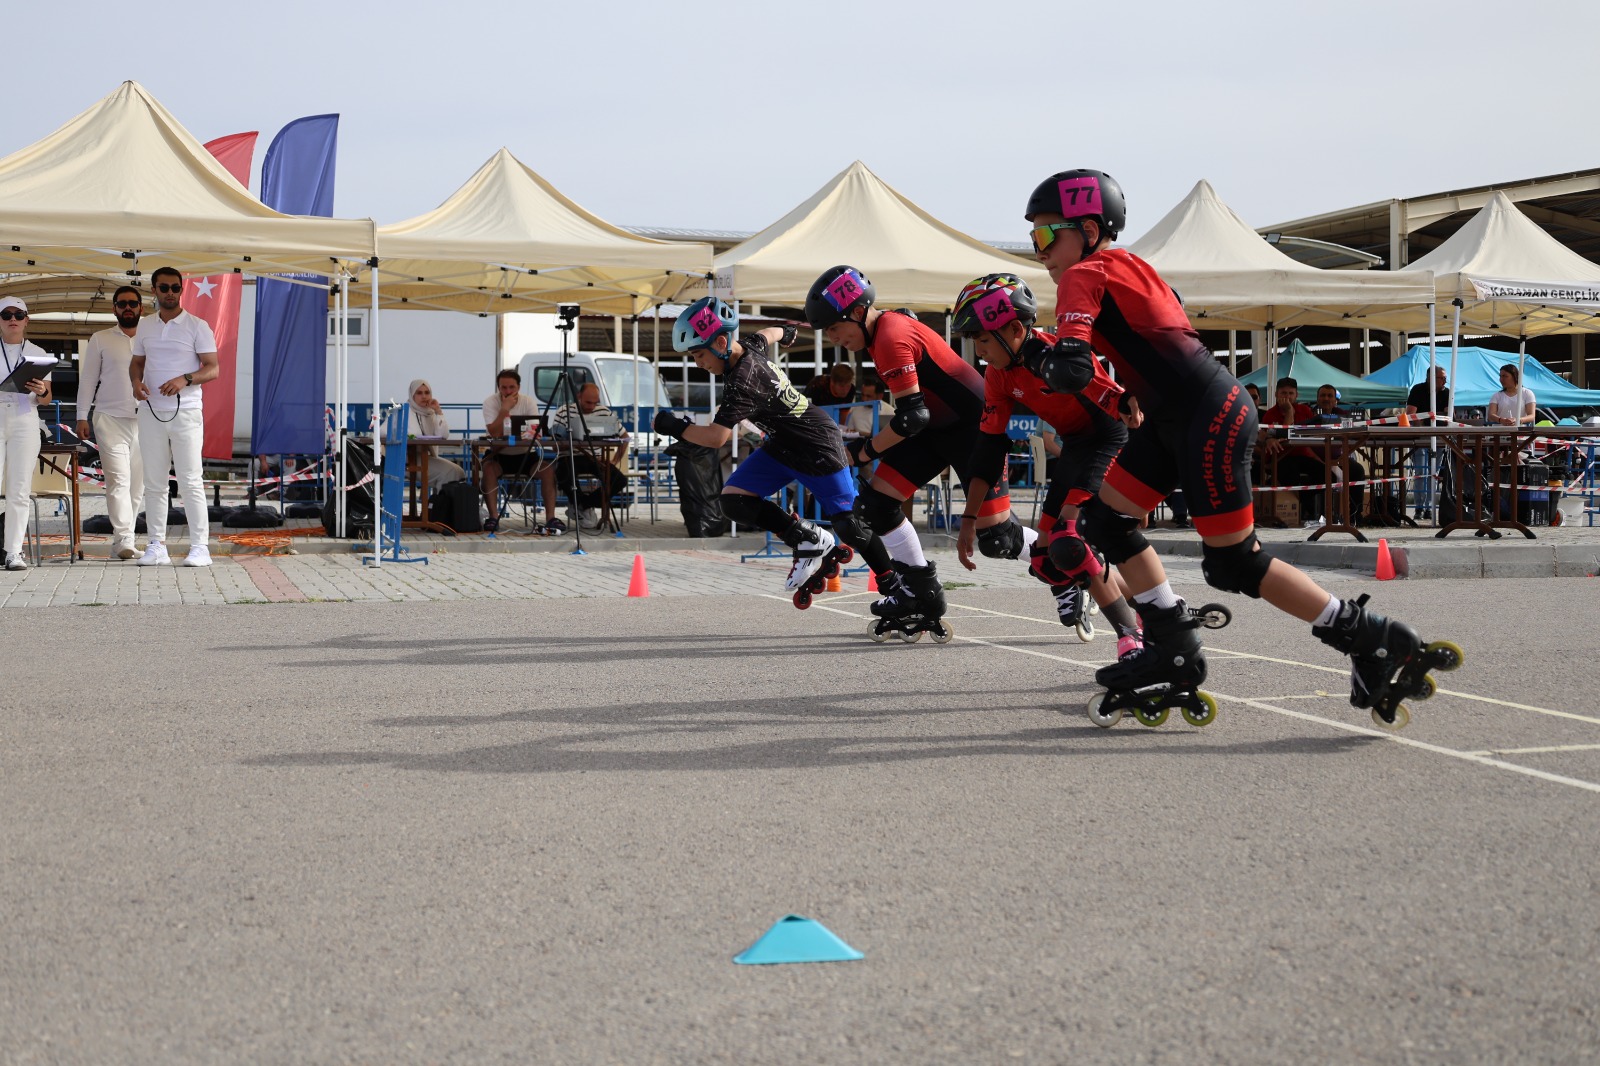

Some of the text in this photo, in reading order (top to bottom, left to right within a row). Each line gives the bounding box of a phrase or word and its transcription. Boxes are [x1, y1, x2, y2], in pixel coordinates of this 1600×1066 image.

[1065, 186, 1095, 206] 77
[834, 279, 857, 299] 78
[1490, 286, 1548, 298] KARAMAN
[1550, 288, 1600, 302] GENÇLİK
[983, 299, 1010, 322] 64
[696, 314, 716, 331] 82
[1009, 420, 1036, 430] POL
[1202, 385, 1240, 509] Turkish Skate
[1221, 404, 1249, 493] Federation
